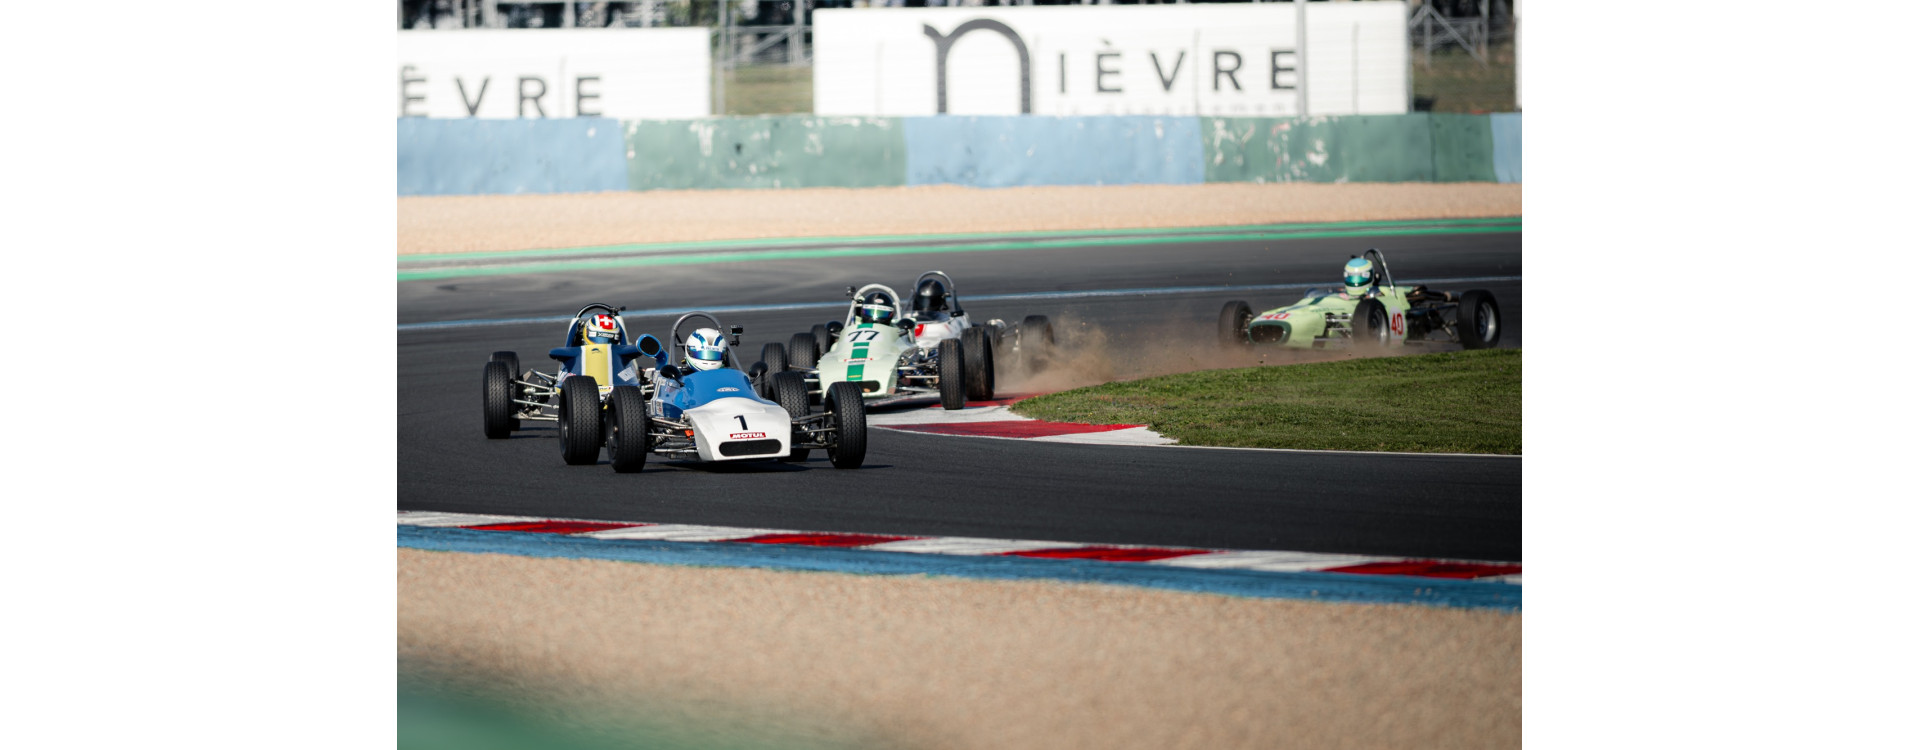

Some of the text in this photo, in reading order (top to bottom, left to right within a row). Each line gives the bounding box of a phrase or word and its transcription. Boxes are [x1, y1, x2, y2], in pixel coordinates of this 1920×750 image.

[1391, 312, 1404, 336] 40
[848, 330, 880, 343] 77
[733, 414, 748, 431] 1
